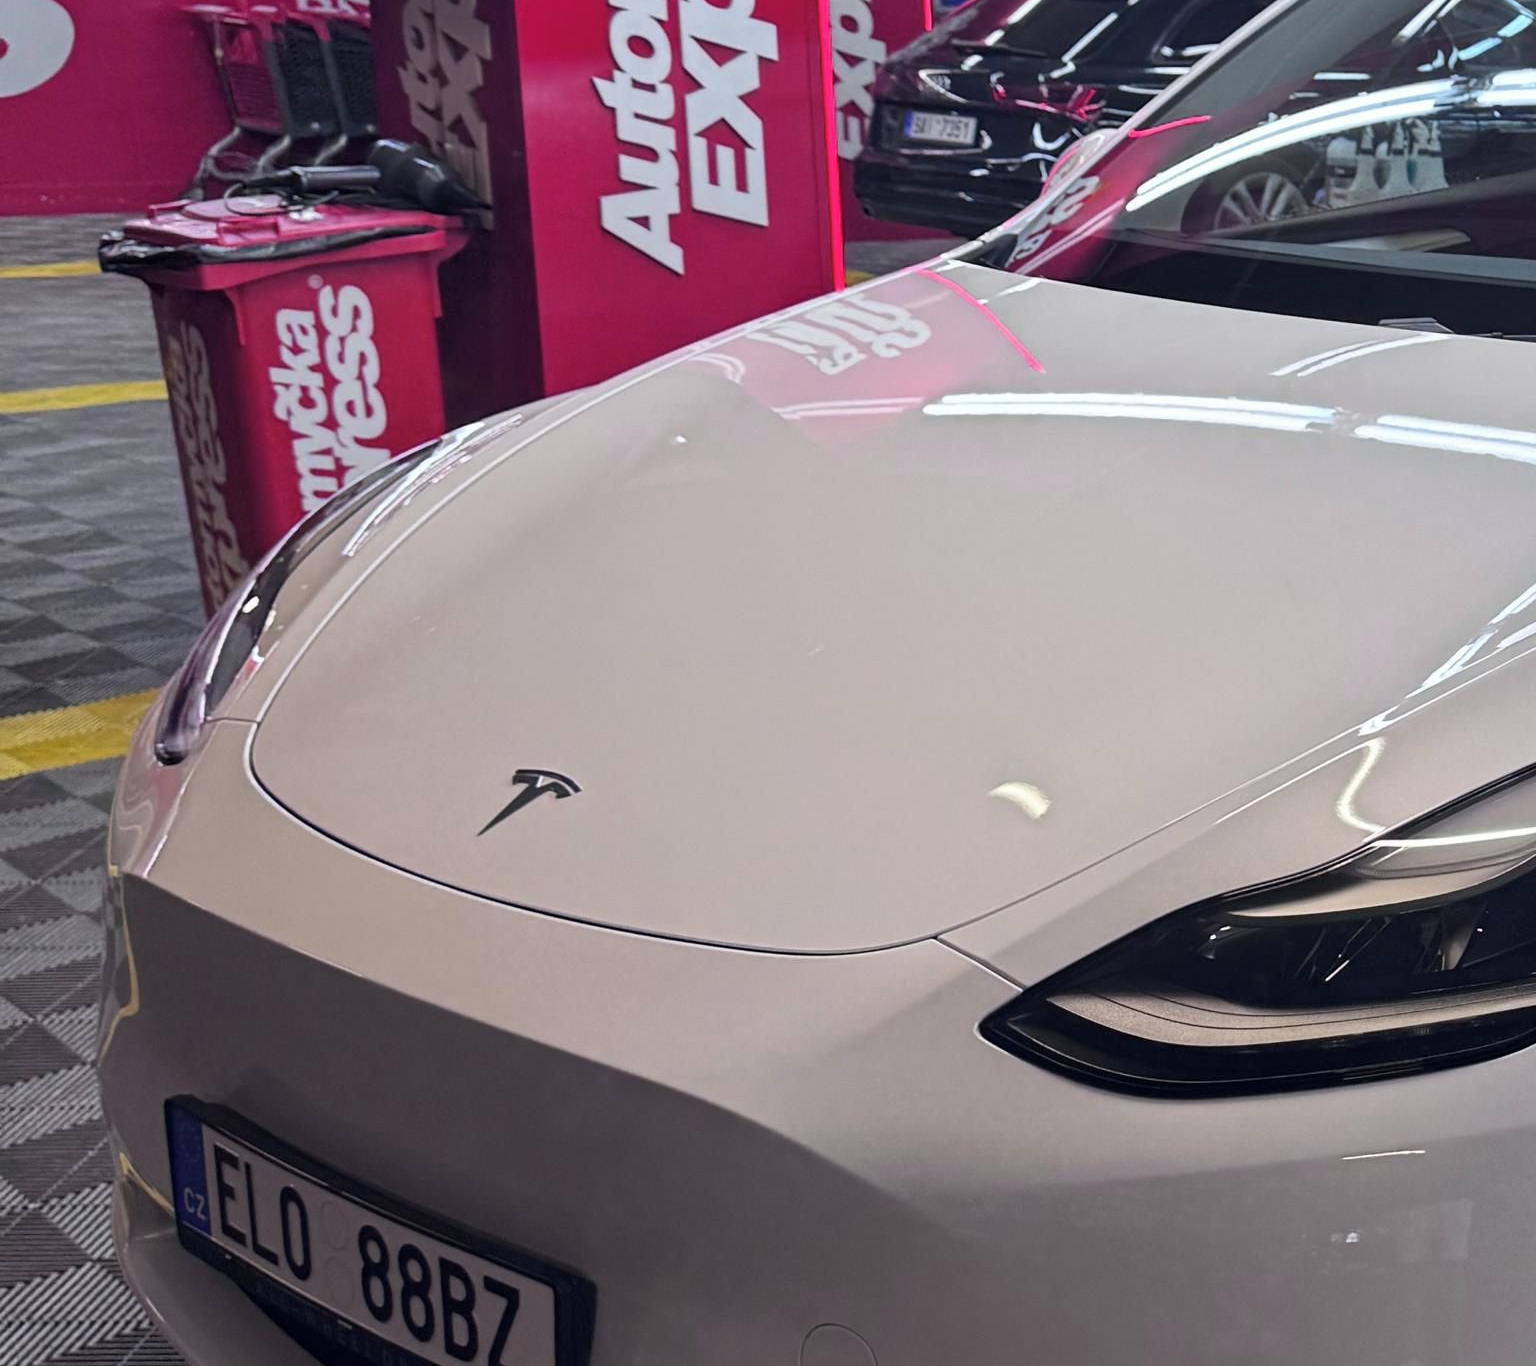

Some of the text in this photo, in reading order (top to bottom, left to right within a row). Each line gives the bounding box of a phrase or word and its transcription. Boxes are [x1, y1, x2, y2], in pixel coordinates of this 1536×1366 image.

[268, 308, 340, 513] myčka
[318, 284, 391, 486] ress
[183, 1186, 208, 1222] CZ
